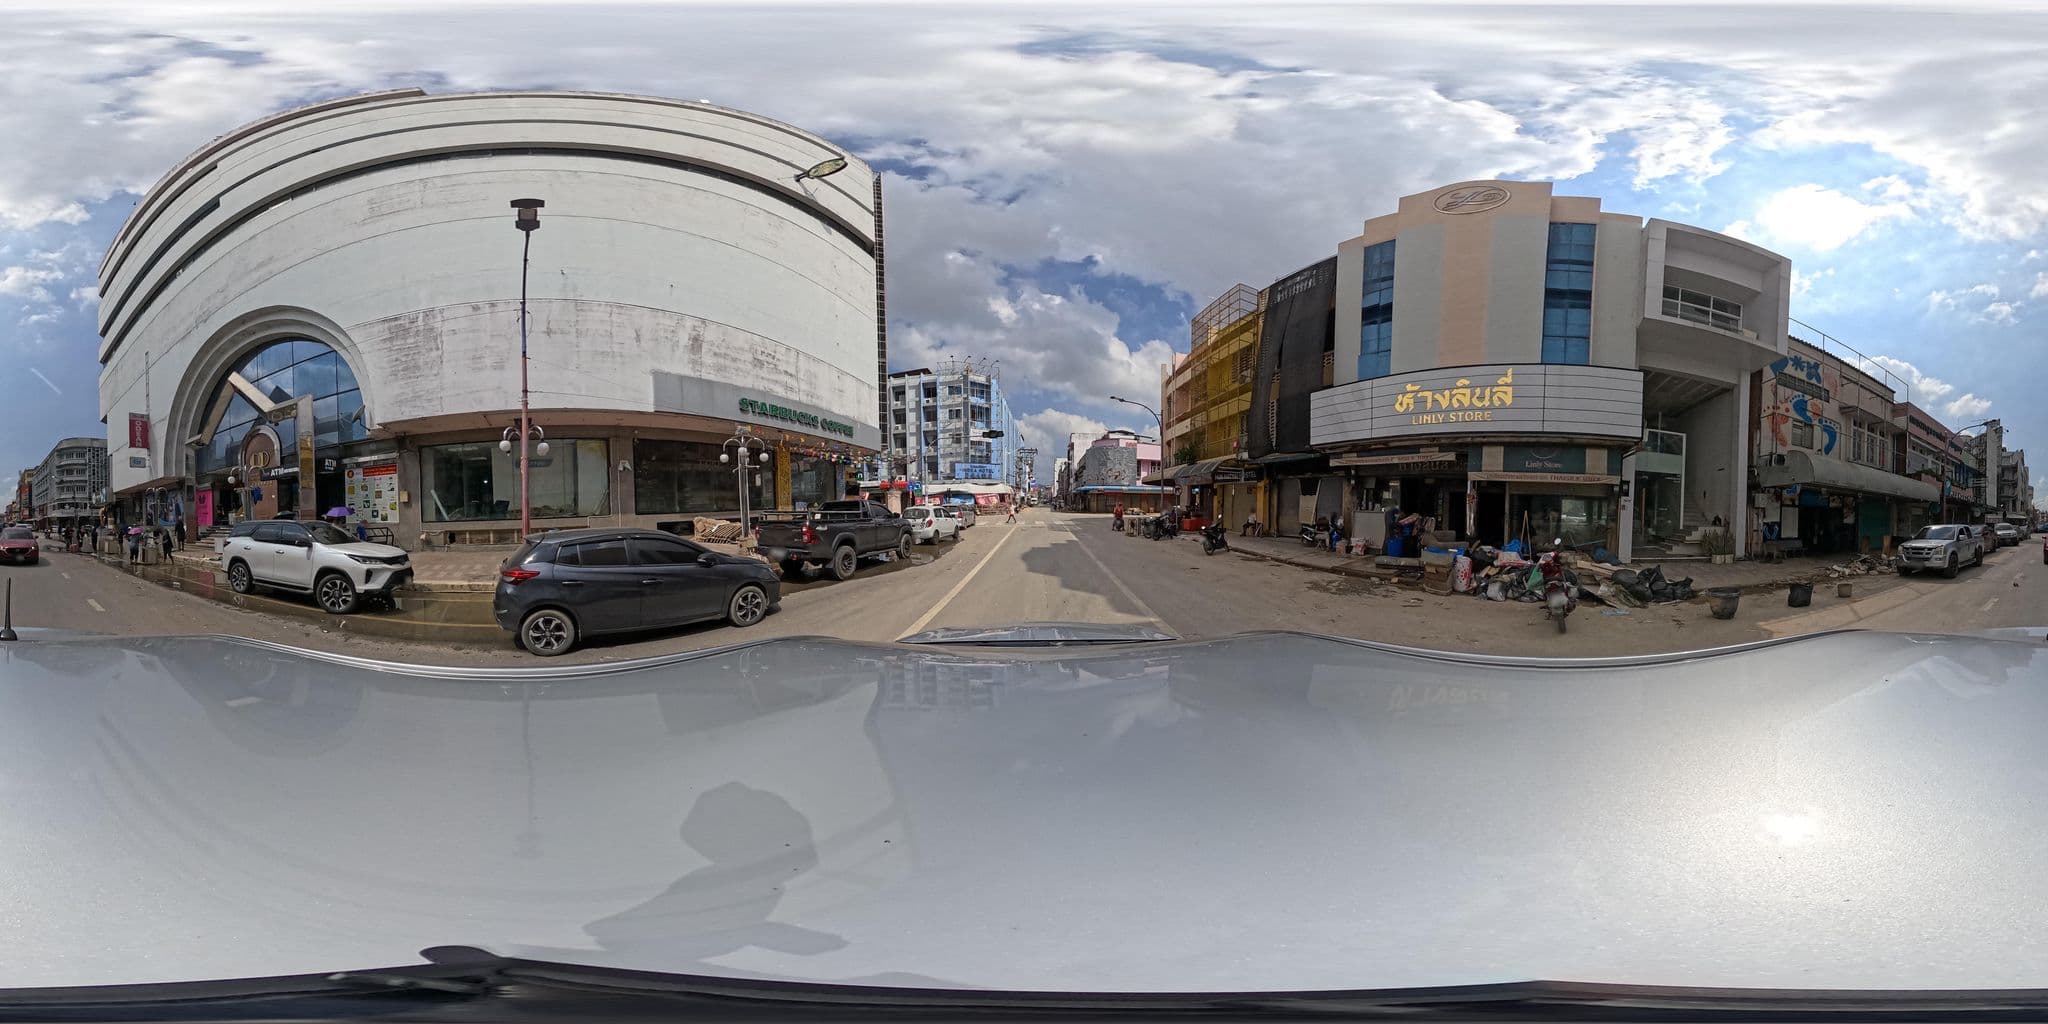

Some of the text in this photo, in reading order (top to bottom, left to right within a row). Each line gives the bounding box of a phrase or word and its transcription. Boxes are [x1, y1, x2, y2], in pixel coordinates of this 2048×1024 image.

[1394, 367, 1513, 413] ห้างลินลี่
[738, 397, 854, 438] STARBUCKS COFFEE
[1411, 411, 1492, 425] LINLY STORE
[324, 458, 337, 467] ATM
[270, 467, 284, 477] ATM
